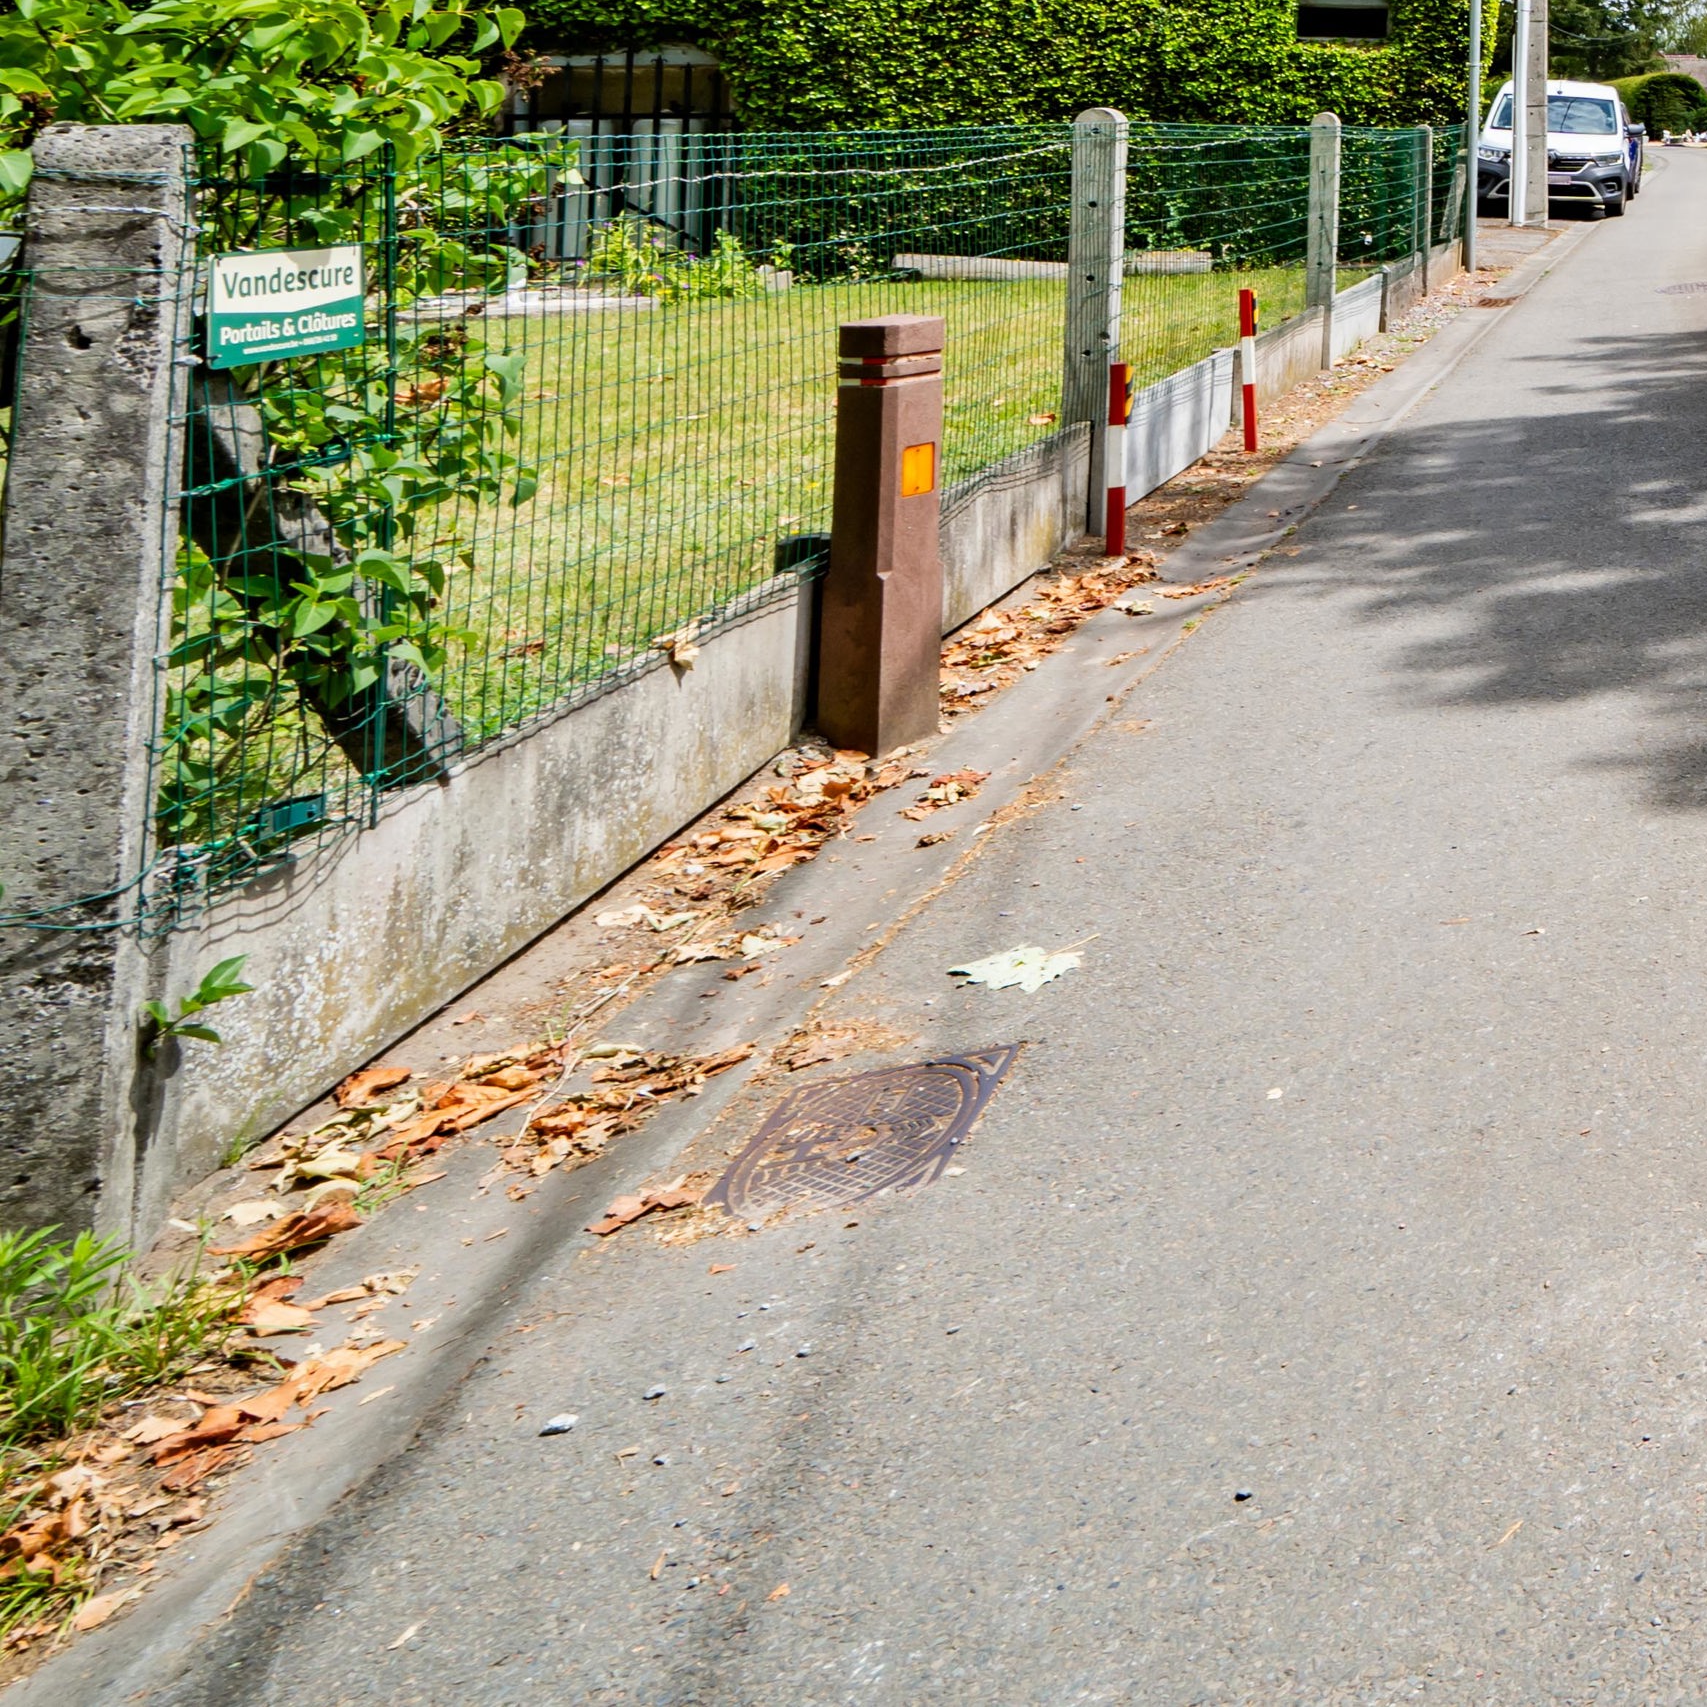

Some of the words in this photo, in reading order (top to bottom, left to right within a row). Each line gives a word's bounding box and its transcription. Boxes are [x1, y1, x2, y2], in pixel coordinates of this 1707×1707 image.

[222, 264, 353, 299] Vandescure
[220, 319, 281, 345] Portails
[282, 318, 296, 336] &
[297, 312, 357, 334] Clôtures
